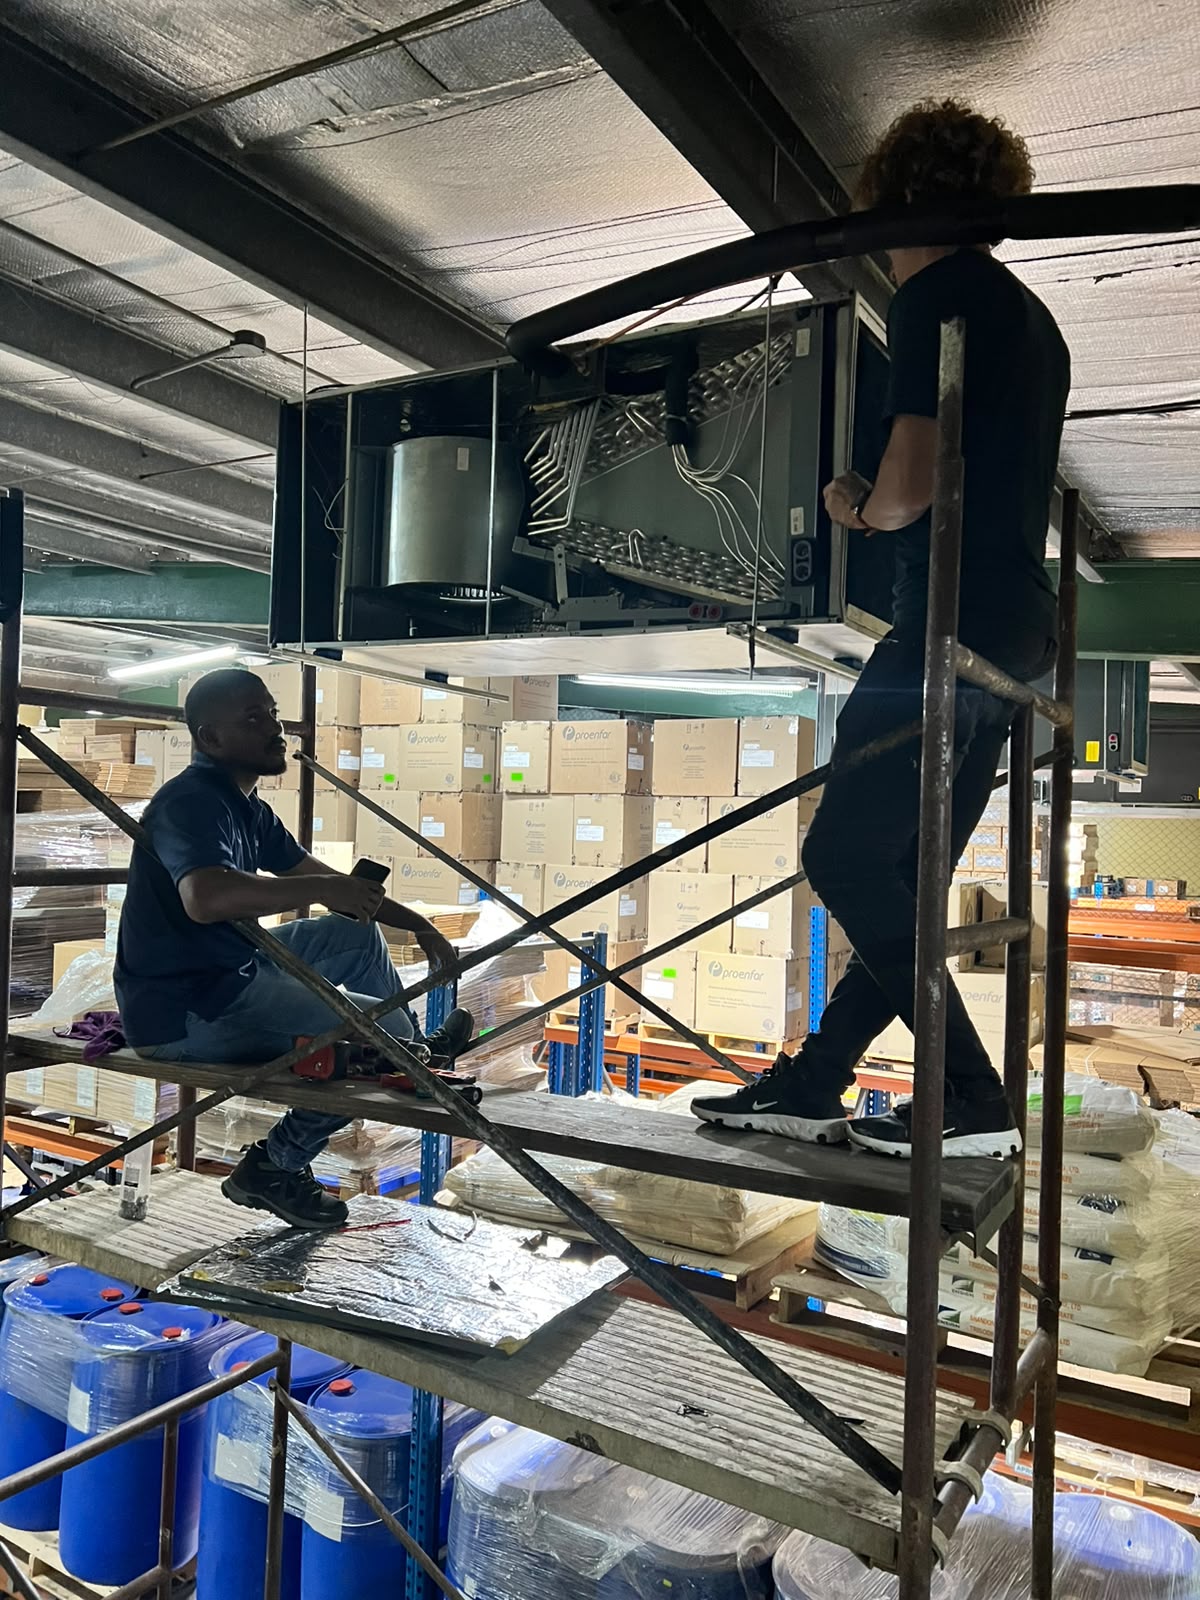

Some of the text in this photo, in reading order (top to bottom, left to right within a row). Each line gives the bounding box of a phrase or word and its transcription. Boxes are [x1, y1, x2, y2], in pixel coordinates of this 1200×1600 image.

[417, 733, 447, 744] proenfar
[574, 729, 611, 742] proenfar
[411, 868, 441, 879] proenfar
[565, 878, 597, 889] proenf
[721, 969, 765, 981] proenfar
[961, 990, 1004, 1003] roenfar
